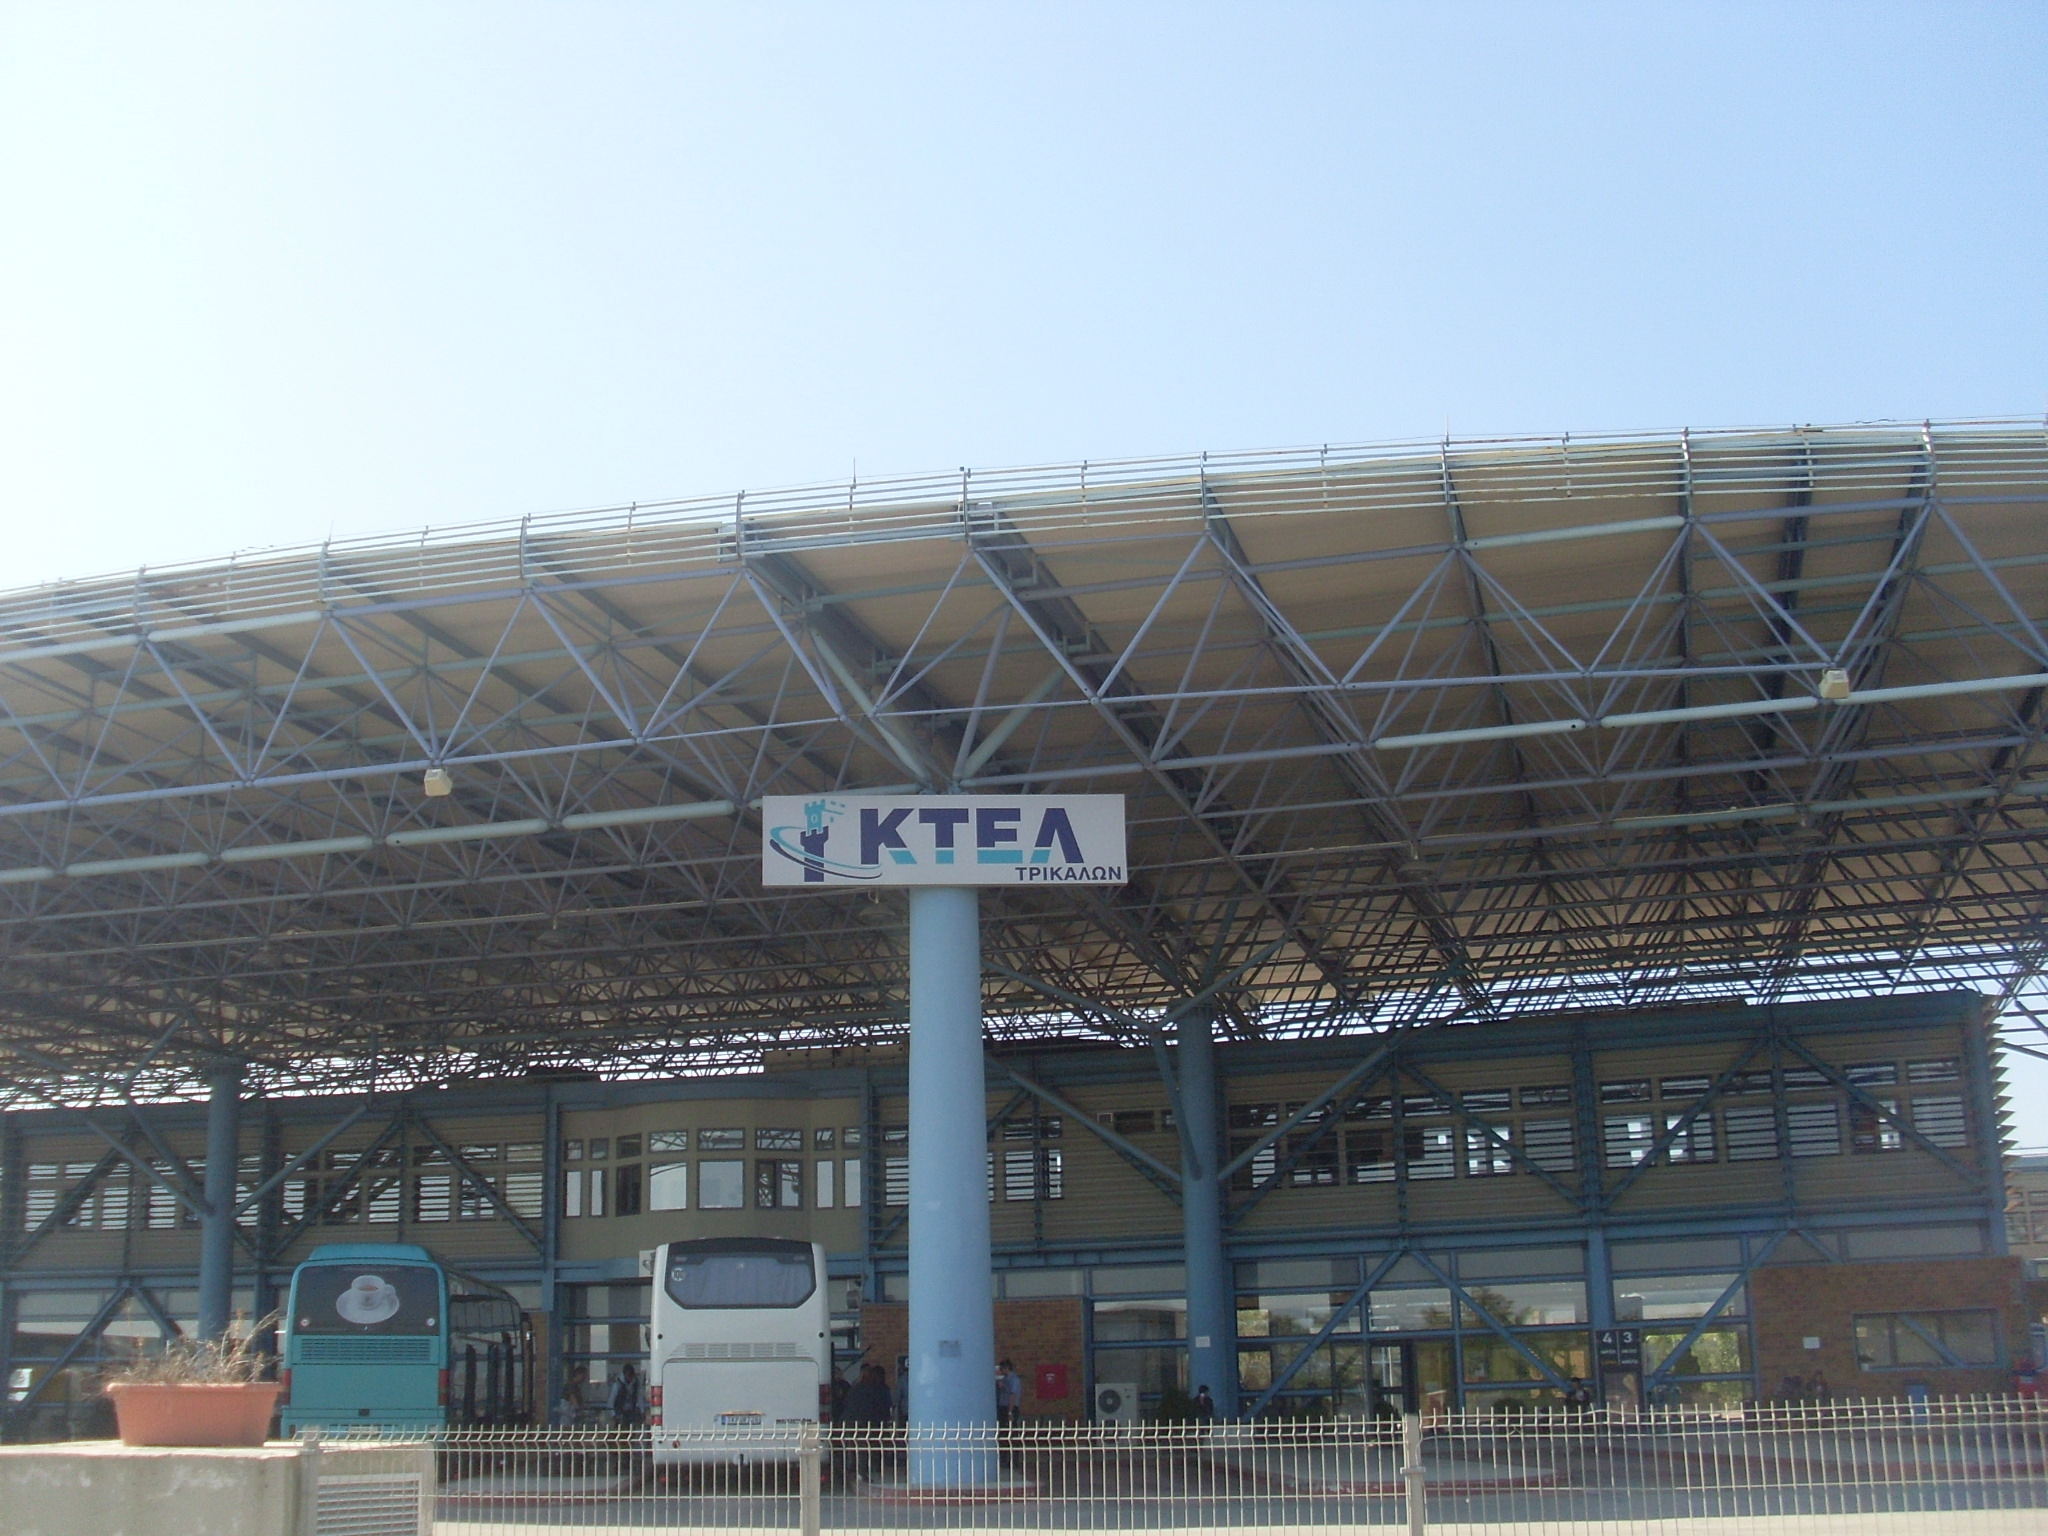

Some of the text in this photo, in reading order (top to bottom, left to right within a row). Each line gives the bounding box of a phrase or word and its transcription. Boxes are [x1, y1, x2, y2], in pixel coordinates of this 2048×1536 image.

[860, 807, 1084, 865] ΚΤΕΛ
[1015, 866, 1122, 882] ΤΡΙΚΑΛΩΝ
[1602, 1331, 1632, 1343] 4 3
